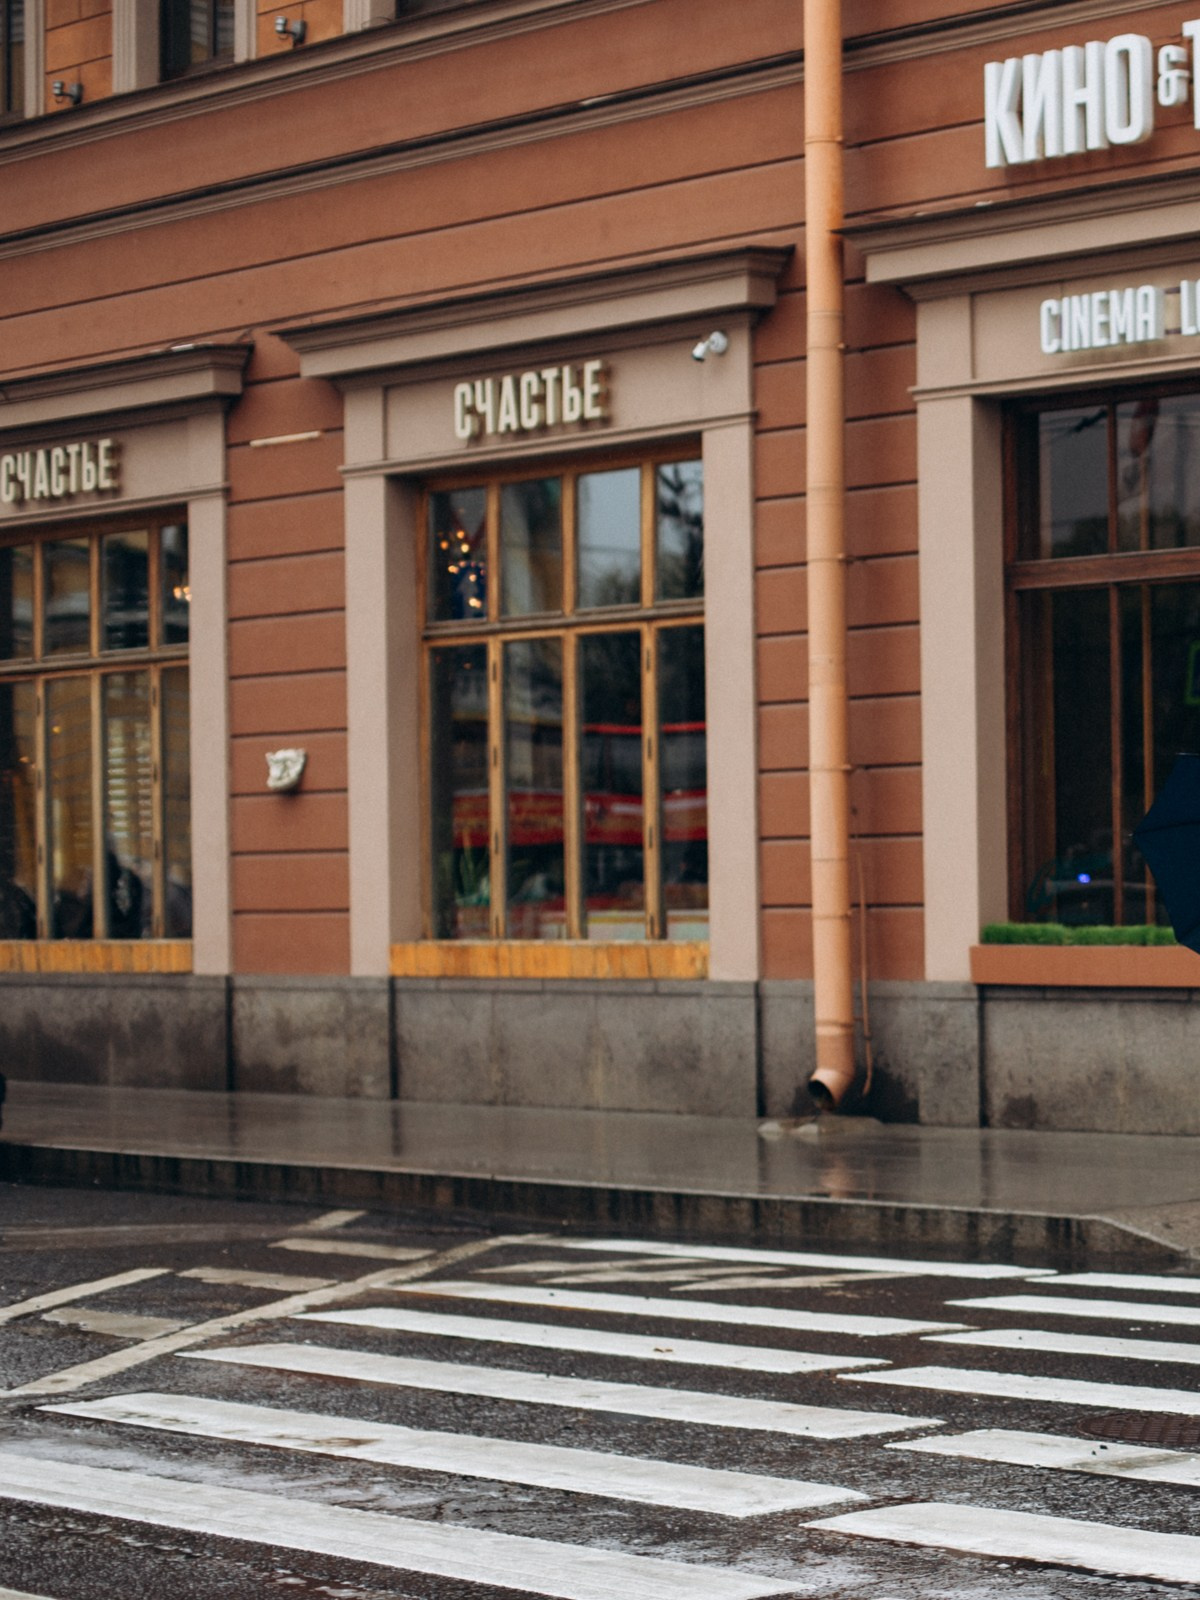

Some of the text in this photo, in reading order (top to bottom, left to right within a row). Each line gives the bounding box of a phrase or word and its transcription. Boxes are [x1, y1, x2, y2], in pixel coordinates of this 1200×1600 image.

[1040, 285, 1161, 353] CINEMA
[454, 360, 605, 440] СЧАСТЬЕ
[1, 438, 114, 503] СЧАСТЬЕ
